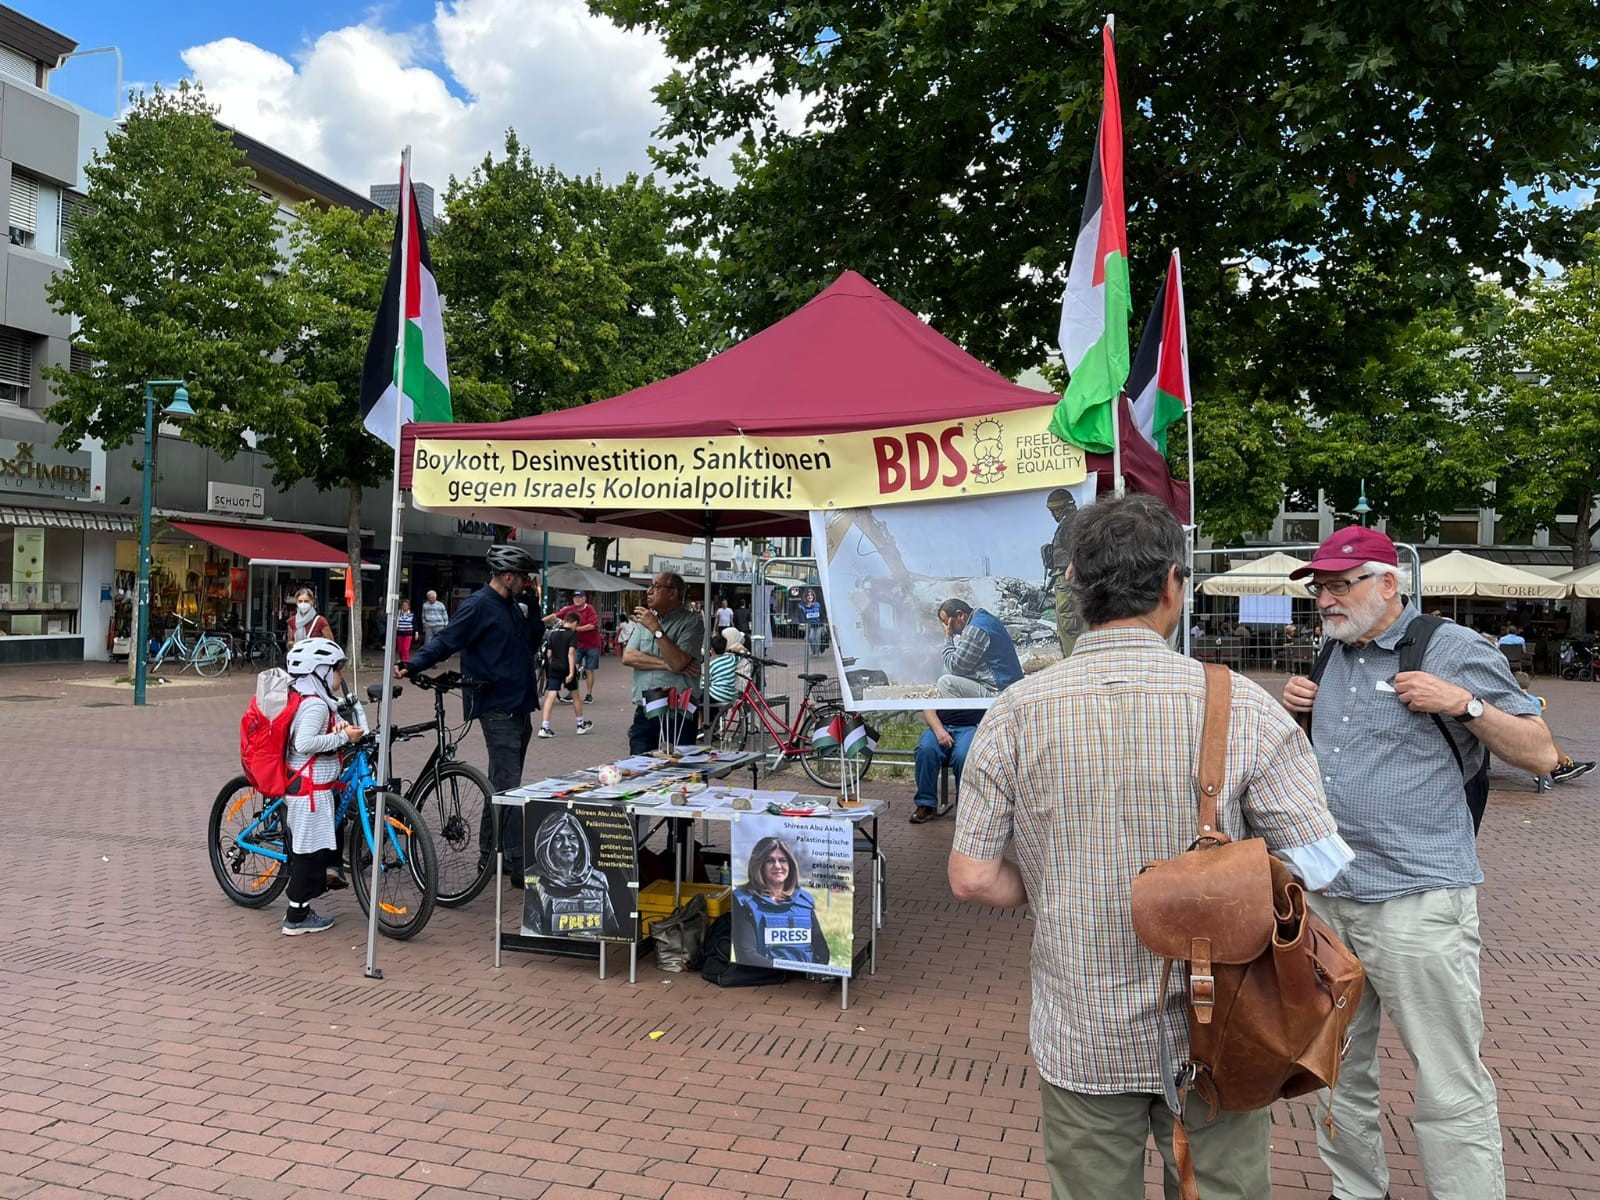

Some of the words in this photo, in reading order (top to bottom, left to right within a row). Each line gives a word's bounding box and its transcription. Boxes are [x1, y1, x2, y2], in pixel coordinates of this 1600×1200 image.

[1016, 433, 1068, 449] FREED
[1017, 443, 1071, 460] JUSTICE
[415, 449, 505, 475] Boykott,
[512, 448, 685, 473] Desinvestition,
[693, 445, 831, 470] Sanktionen
[873, 427, 968, 494] BDS
[1017, 456, 1082, 474] EQUALITY
[449, 480, 517, 502] gegen
[524, 477, 596, 498] Israels
[603, 475, 792, 504] Kolonialpolitik!
[215, 495, 250, 507] SCHUGT
[1498, 584, 1541, 596] TORRI
[783, 822, 809, 830] Shireen
[811, 849, 850, 858] Journalistin
[559, 914, 601, 930] PRESS
[771, 930, 808, 942] PRESS
